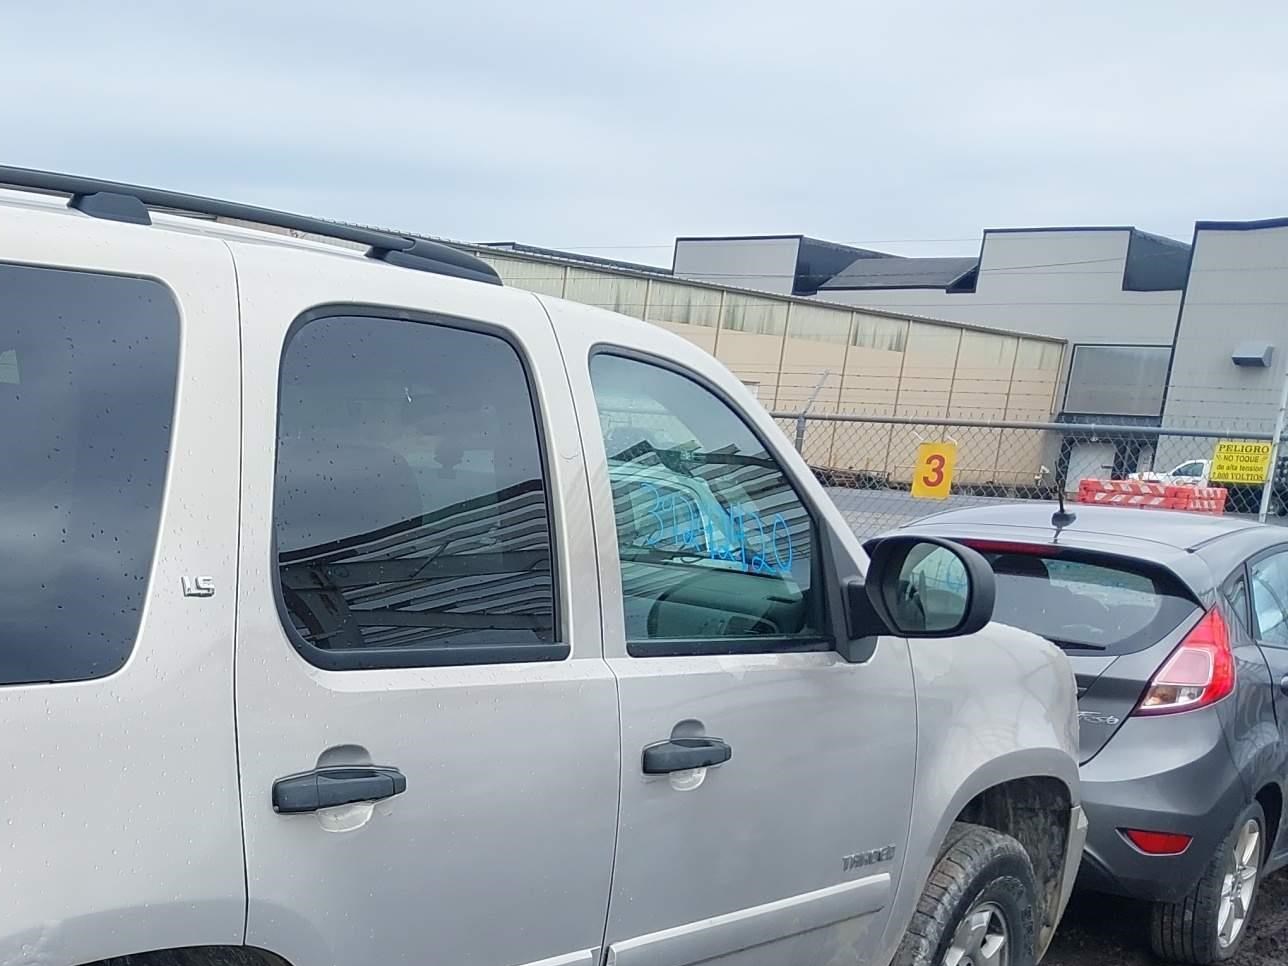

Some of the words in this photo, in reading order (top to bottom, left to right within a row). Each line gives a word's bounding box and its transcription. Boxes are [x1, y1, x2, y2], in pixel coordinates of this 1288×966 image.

[1218, 444, 1270, 453] PELIGRO
[1223, 454, 1234, 462] NO
[1235, 455, 1260, 463] TOQUE
[922, 454, 946, 488] 3
[1231, 472, 1264, 481] VOLTIOS
[180, 576, 215, 598] LS
